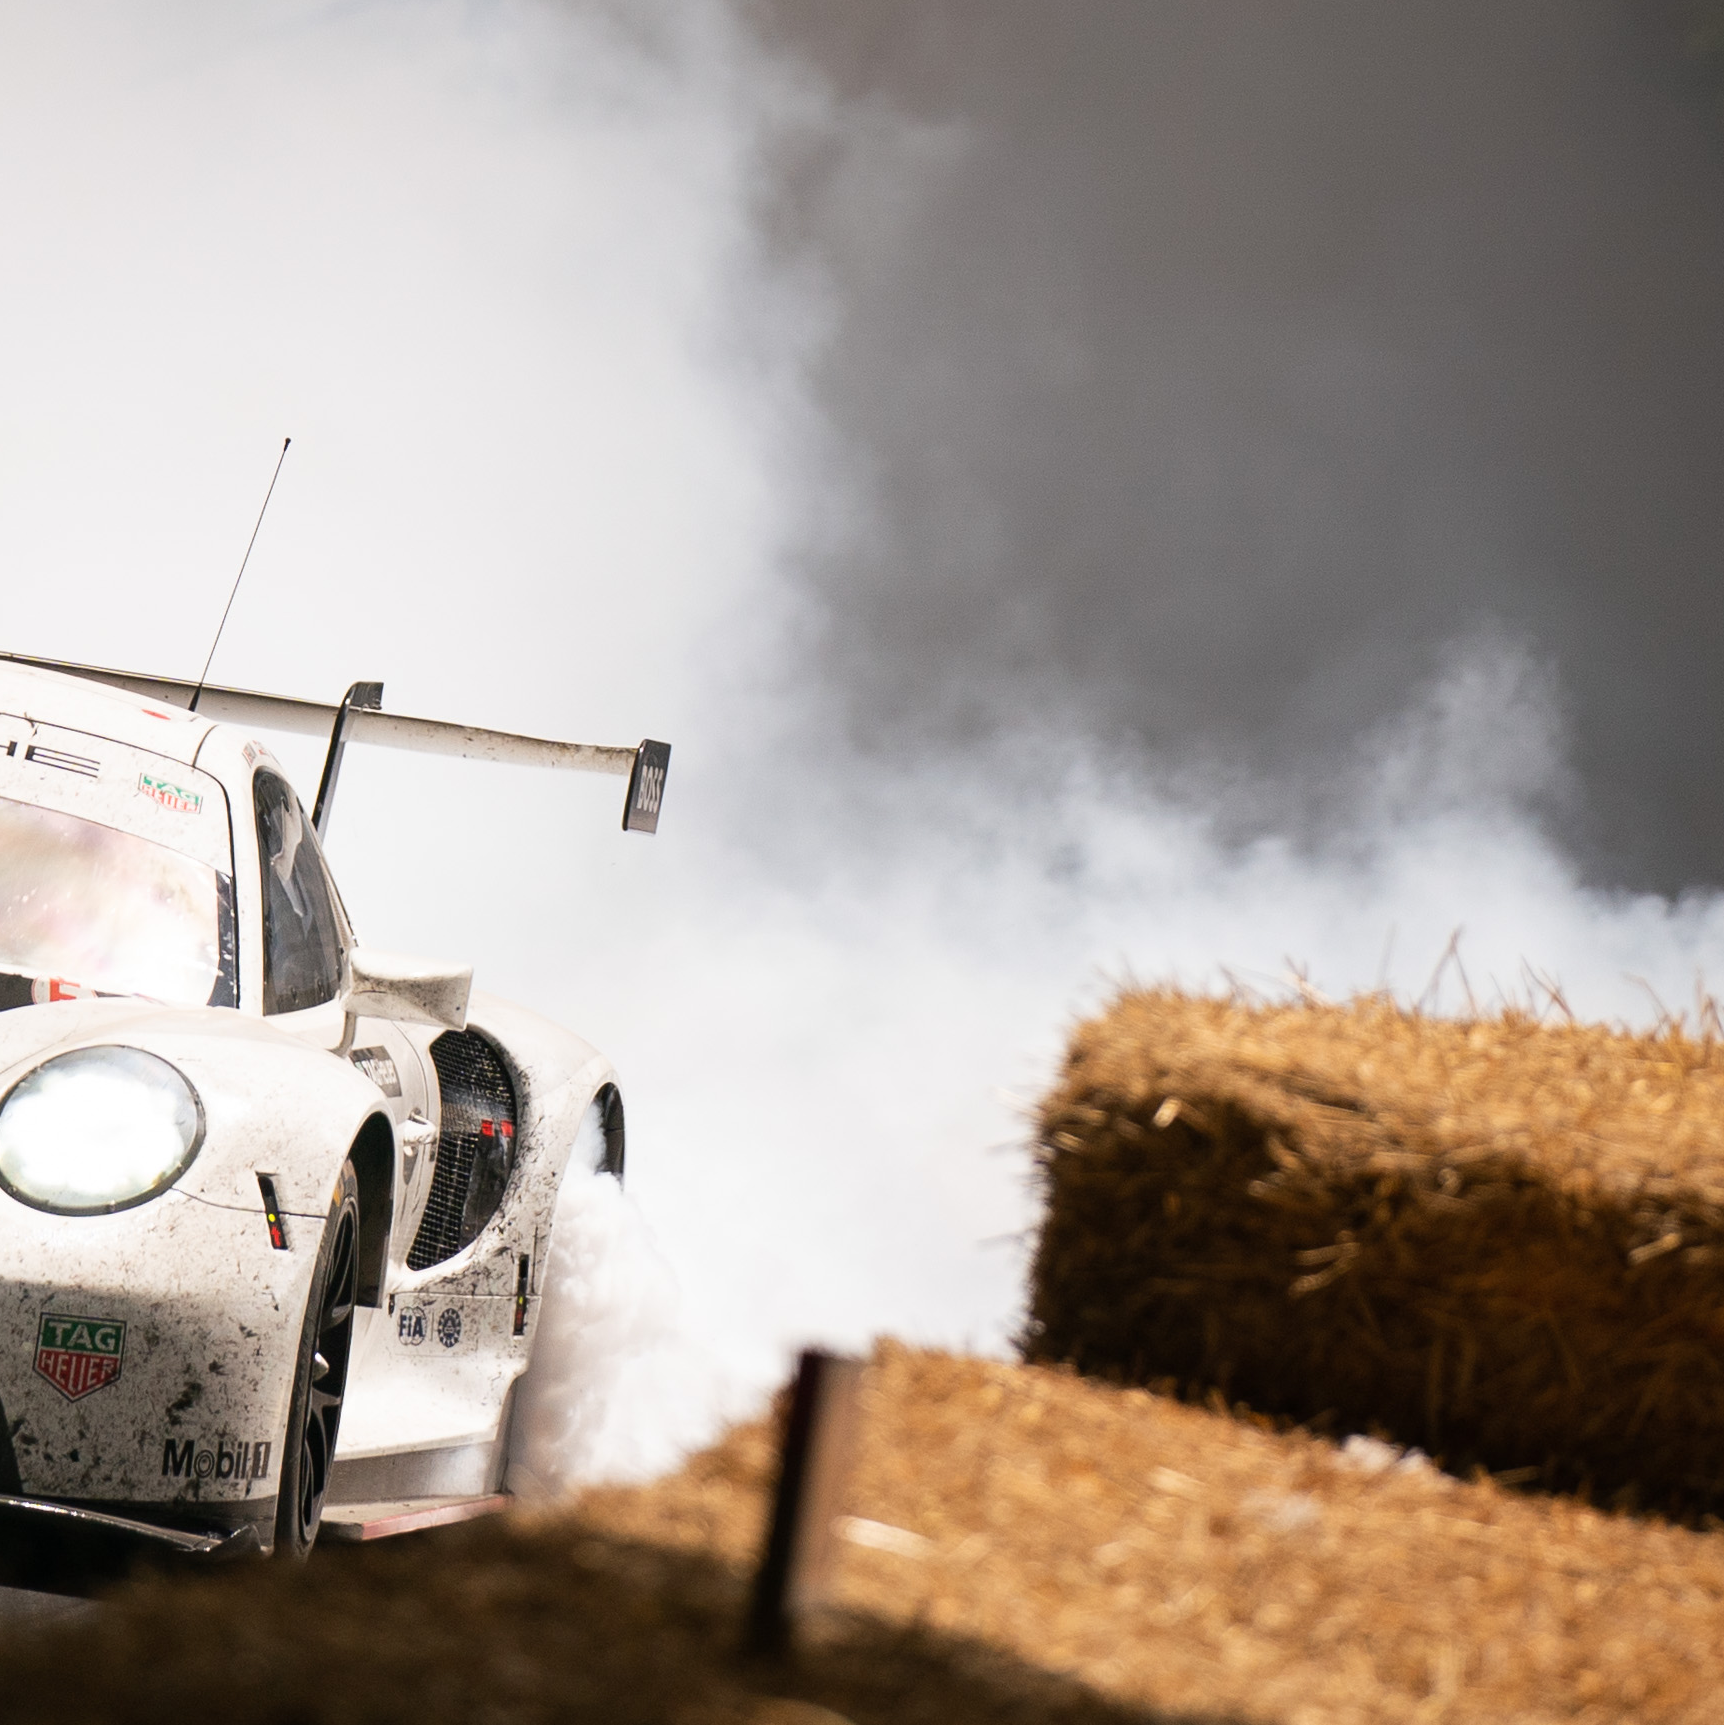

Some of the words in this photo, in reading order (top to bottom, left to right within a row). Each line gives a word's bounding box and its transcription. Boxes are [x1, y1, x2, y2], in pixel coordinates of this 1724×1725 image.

[47, 1321, 117, 1352] TAG
[399, 1314, 425, 1337] FIA
[40, 1351, 116, 1394] HEUER
[161, 1438, 250, 1478] Mobil
